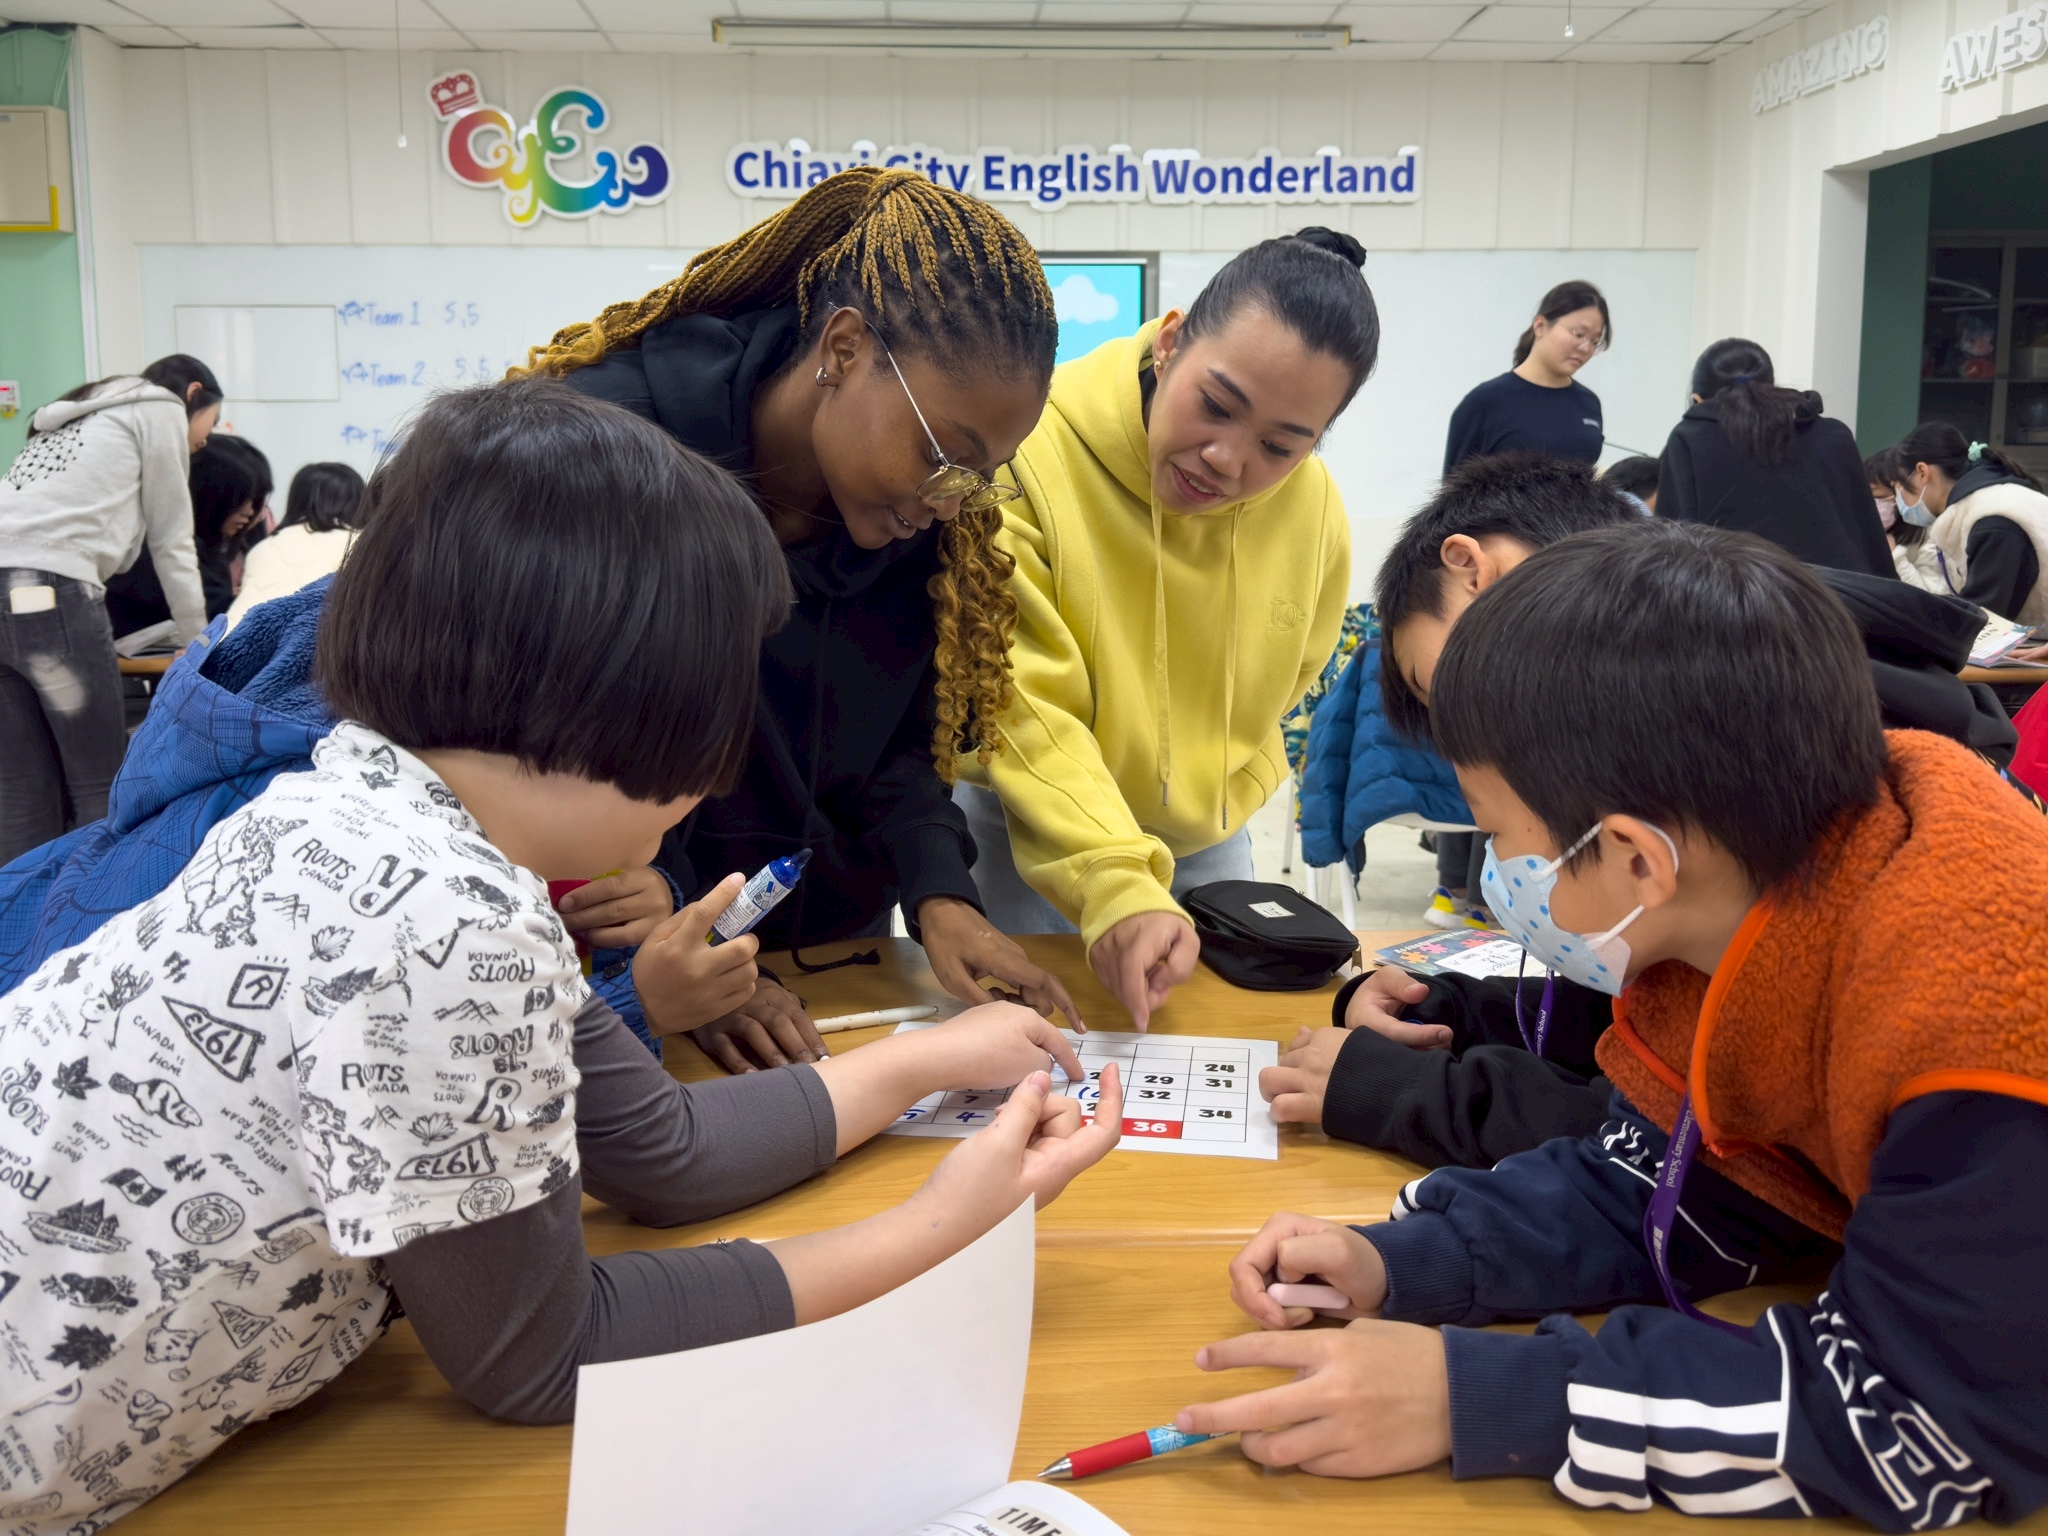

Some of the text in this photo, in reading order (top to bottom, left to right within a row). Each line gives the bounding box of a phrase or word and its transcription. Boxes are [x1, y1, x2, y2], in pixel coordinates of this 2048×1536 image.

[1936, 2, 2048, 93] AWES
[1753, 15, 1889, 115] AMAZING
[733, 149, 871, 188] Chia
[983, 152, 1139, 202] English
[1152, 154, 1415, 195] Wonderland
[366, 302, 403, 327] Team
[370, 363, 407, 387] Team
[411, 360, 426, 386] 2
[329, 807, 366, 827] CANADA
[340, 793, 389, 816] WHEREVER
[344, 826, 373, 840] HOME
[373, 815, 401, 830] ROAM
[292, 837, 357, 881] ROOTS
[298, 866, 344, 894] CANADA
[467, 948, 518, 962] CANADA
[468, 957, 535, 983] ROOTS
[244, 973, 275, 1002] R
[132, 1015, 175, 1053] CANADA
[1537, 1009, 1548, 1034] School
[184, 1011, 244, 1066] 1973
[450, 1023, 534, 1060] ROOTS
[149, 1051, 183, 1078] HOME
[435, 1070, 477, 1083] CANADA
[1089, 1071, 1101, 1080] 2
[1204, 1062, 1236, 1074] 24
[367, 1083, 410, 1098] CNADA
[1144, 1074, 1175, 1086] 29
[1205, 1076, 1233, 1088] 31
[0, 1066, 50, 1136] ROOTS
[433, 1092, 465, 1104] ROOTS
[964, 1095, 980, 1104] 7
[1086, 1102, 1098, 1112] 2
[1138, 1089, 1172, 1101] 32
[249, 1096, 296, 1131] IS HOME
[955, 1111, 986, 1123] 4
[1198, 1107, 1233, 1119] 34
[72, 1120, 110, 1151] CANADA
[220, 1107, 279, 1147] YOU ROAM
[258, 1113, 298, 1151] CANADA
[1132, 1121, 1168, 1134] 36
[0, 1147, 32, 1168] CANA
[51, 1141, 84, 1164] ROOTS
[234, 1129, 288, 1175] WHEREVER
[414, 1144, 481, 1175] 1973
[1666, 1109, 1697, 1188] Elementary School
[0, 1163, 52, 1202] ROO
[210, 1152, 265, 1196] ROOTS
